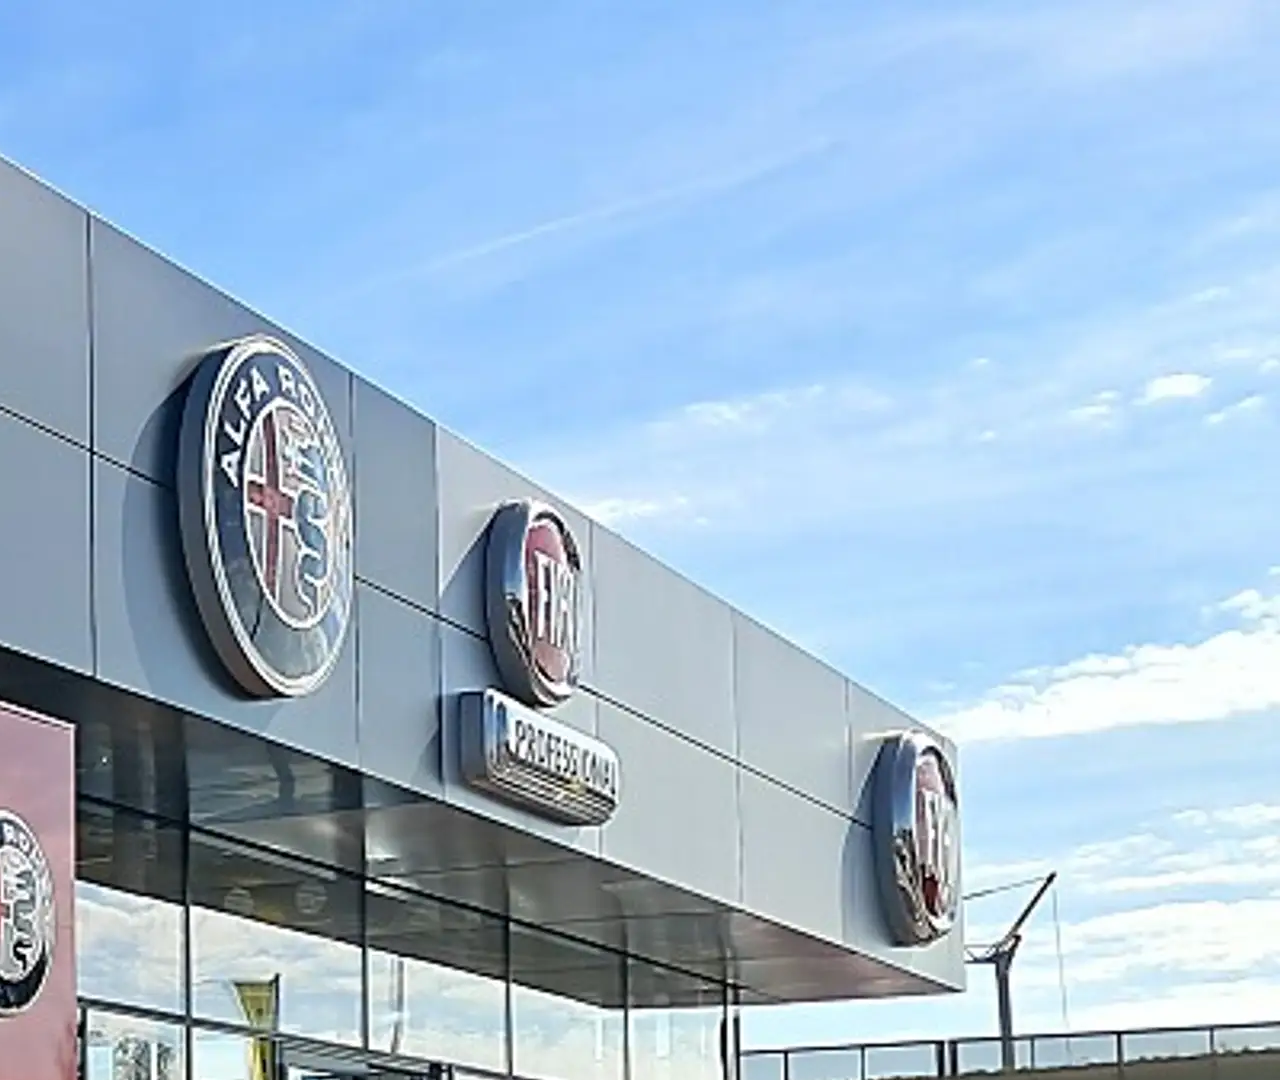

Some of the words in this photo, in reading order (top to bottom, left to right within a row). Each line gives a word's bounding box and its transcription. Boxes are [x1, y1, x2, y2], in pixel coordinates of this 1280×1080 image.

[220, 366, 270, 488] ALFA
[534, 550, 583, 651] FIA
[515, 719, 617, 795] PROFESSONAL
